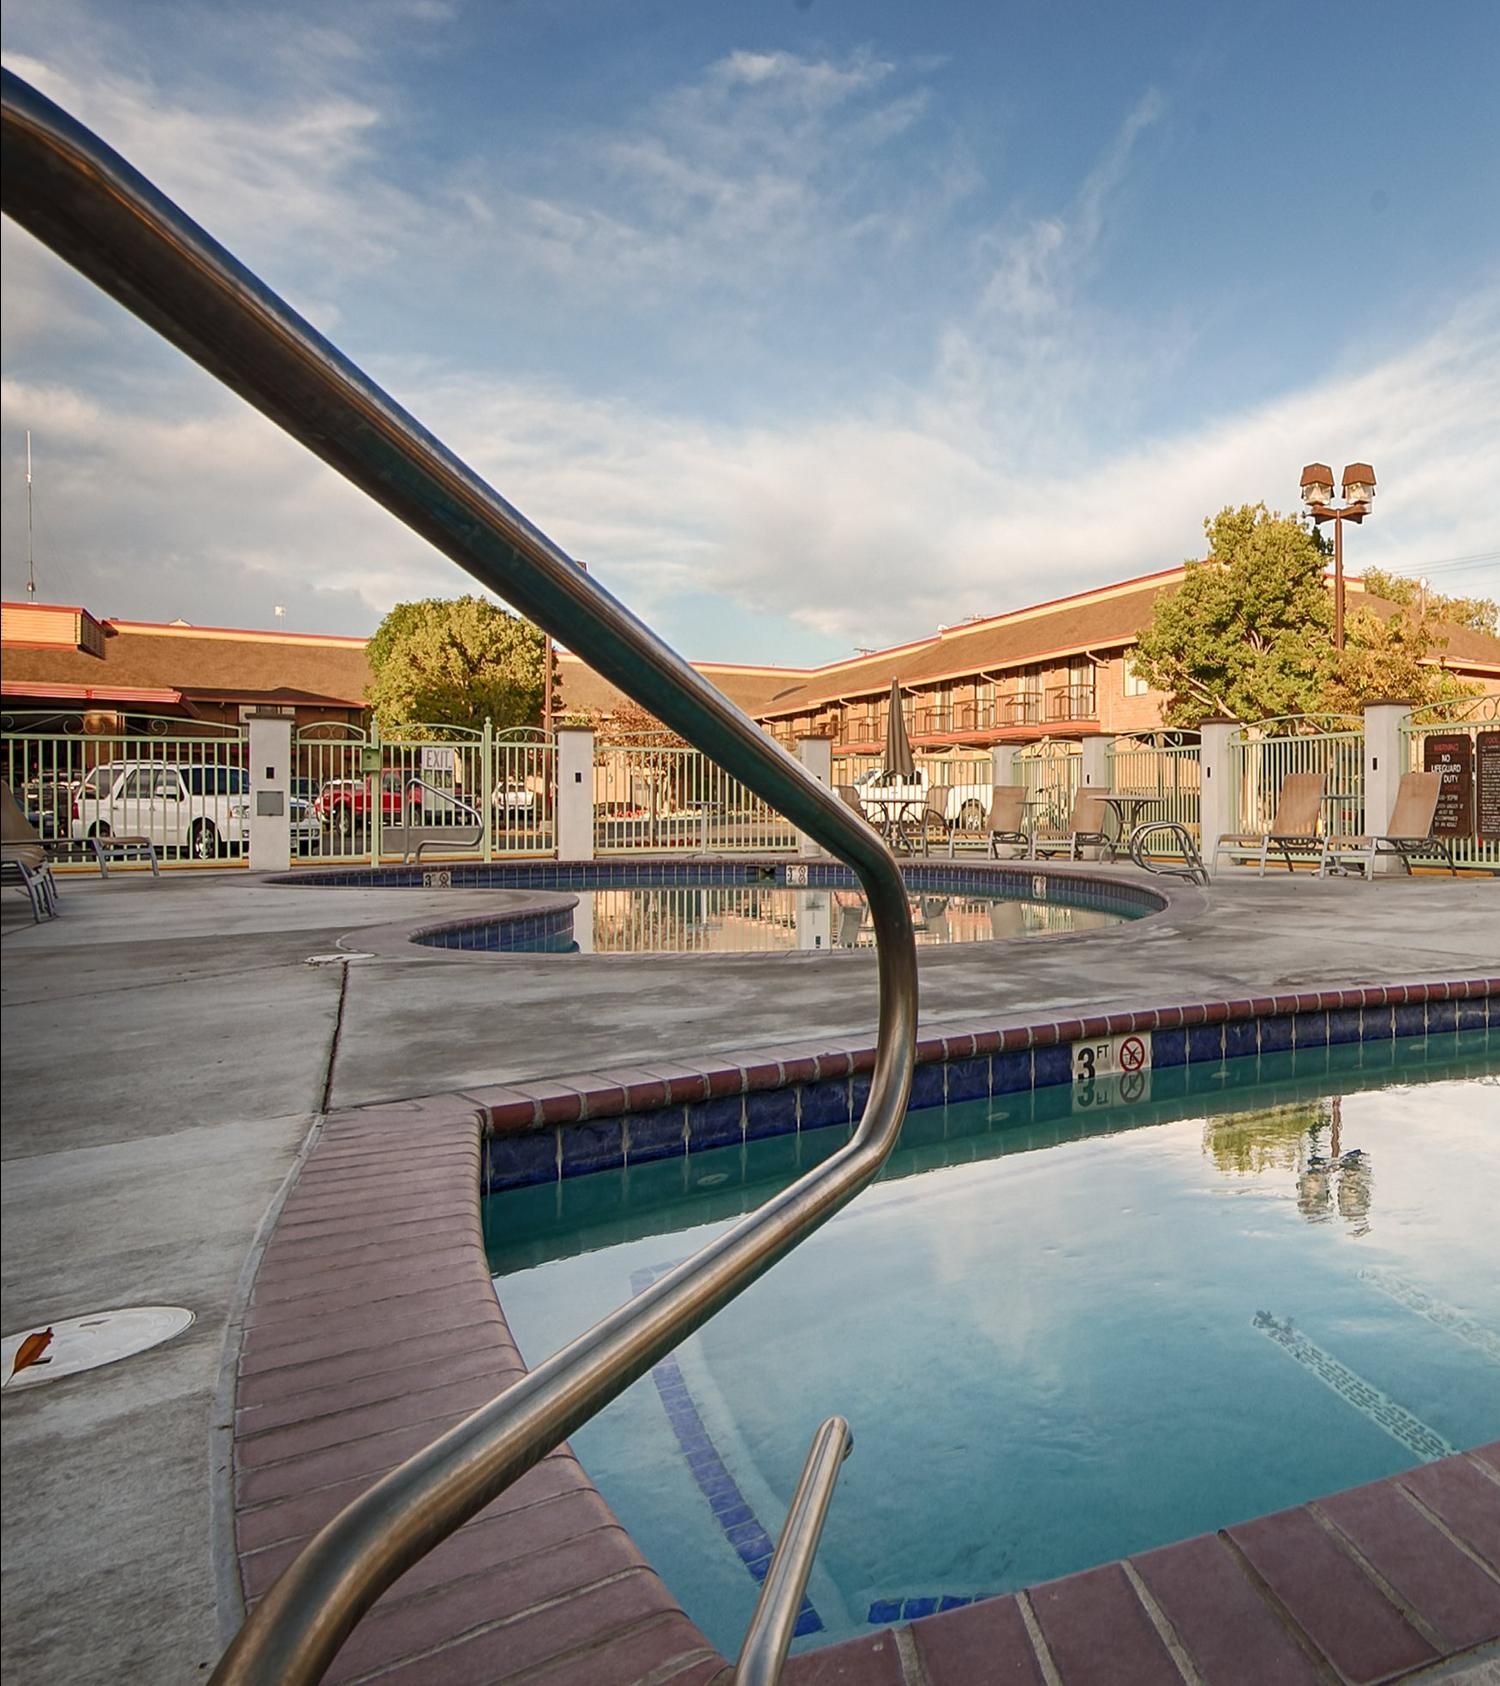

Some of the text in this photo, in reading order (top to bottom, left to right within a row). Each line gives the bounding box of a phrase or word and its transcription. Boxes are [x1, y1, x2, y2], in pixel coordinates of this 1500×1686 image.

[1441, 754, 1451, 763] NO
[1431, 764, 1462, 773] LIFEGUARD
[1443, 775, 1459, 783] DUTY
[1078, 1044, 1109, 1081] 3 FT
